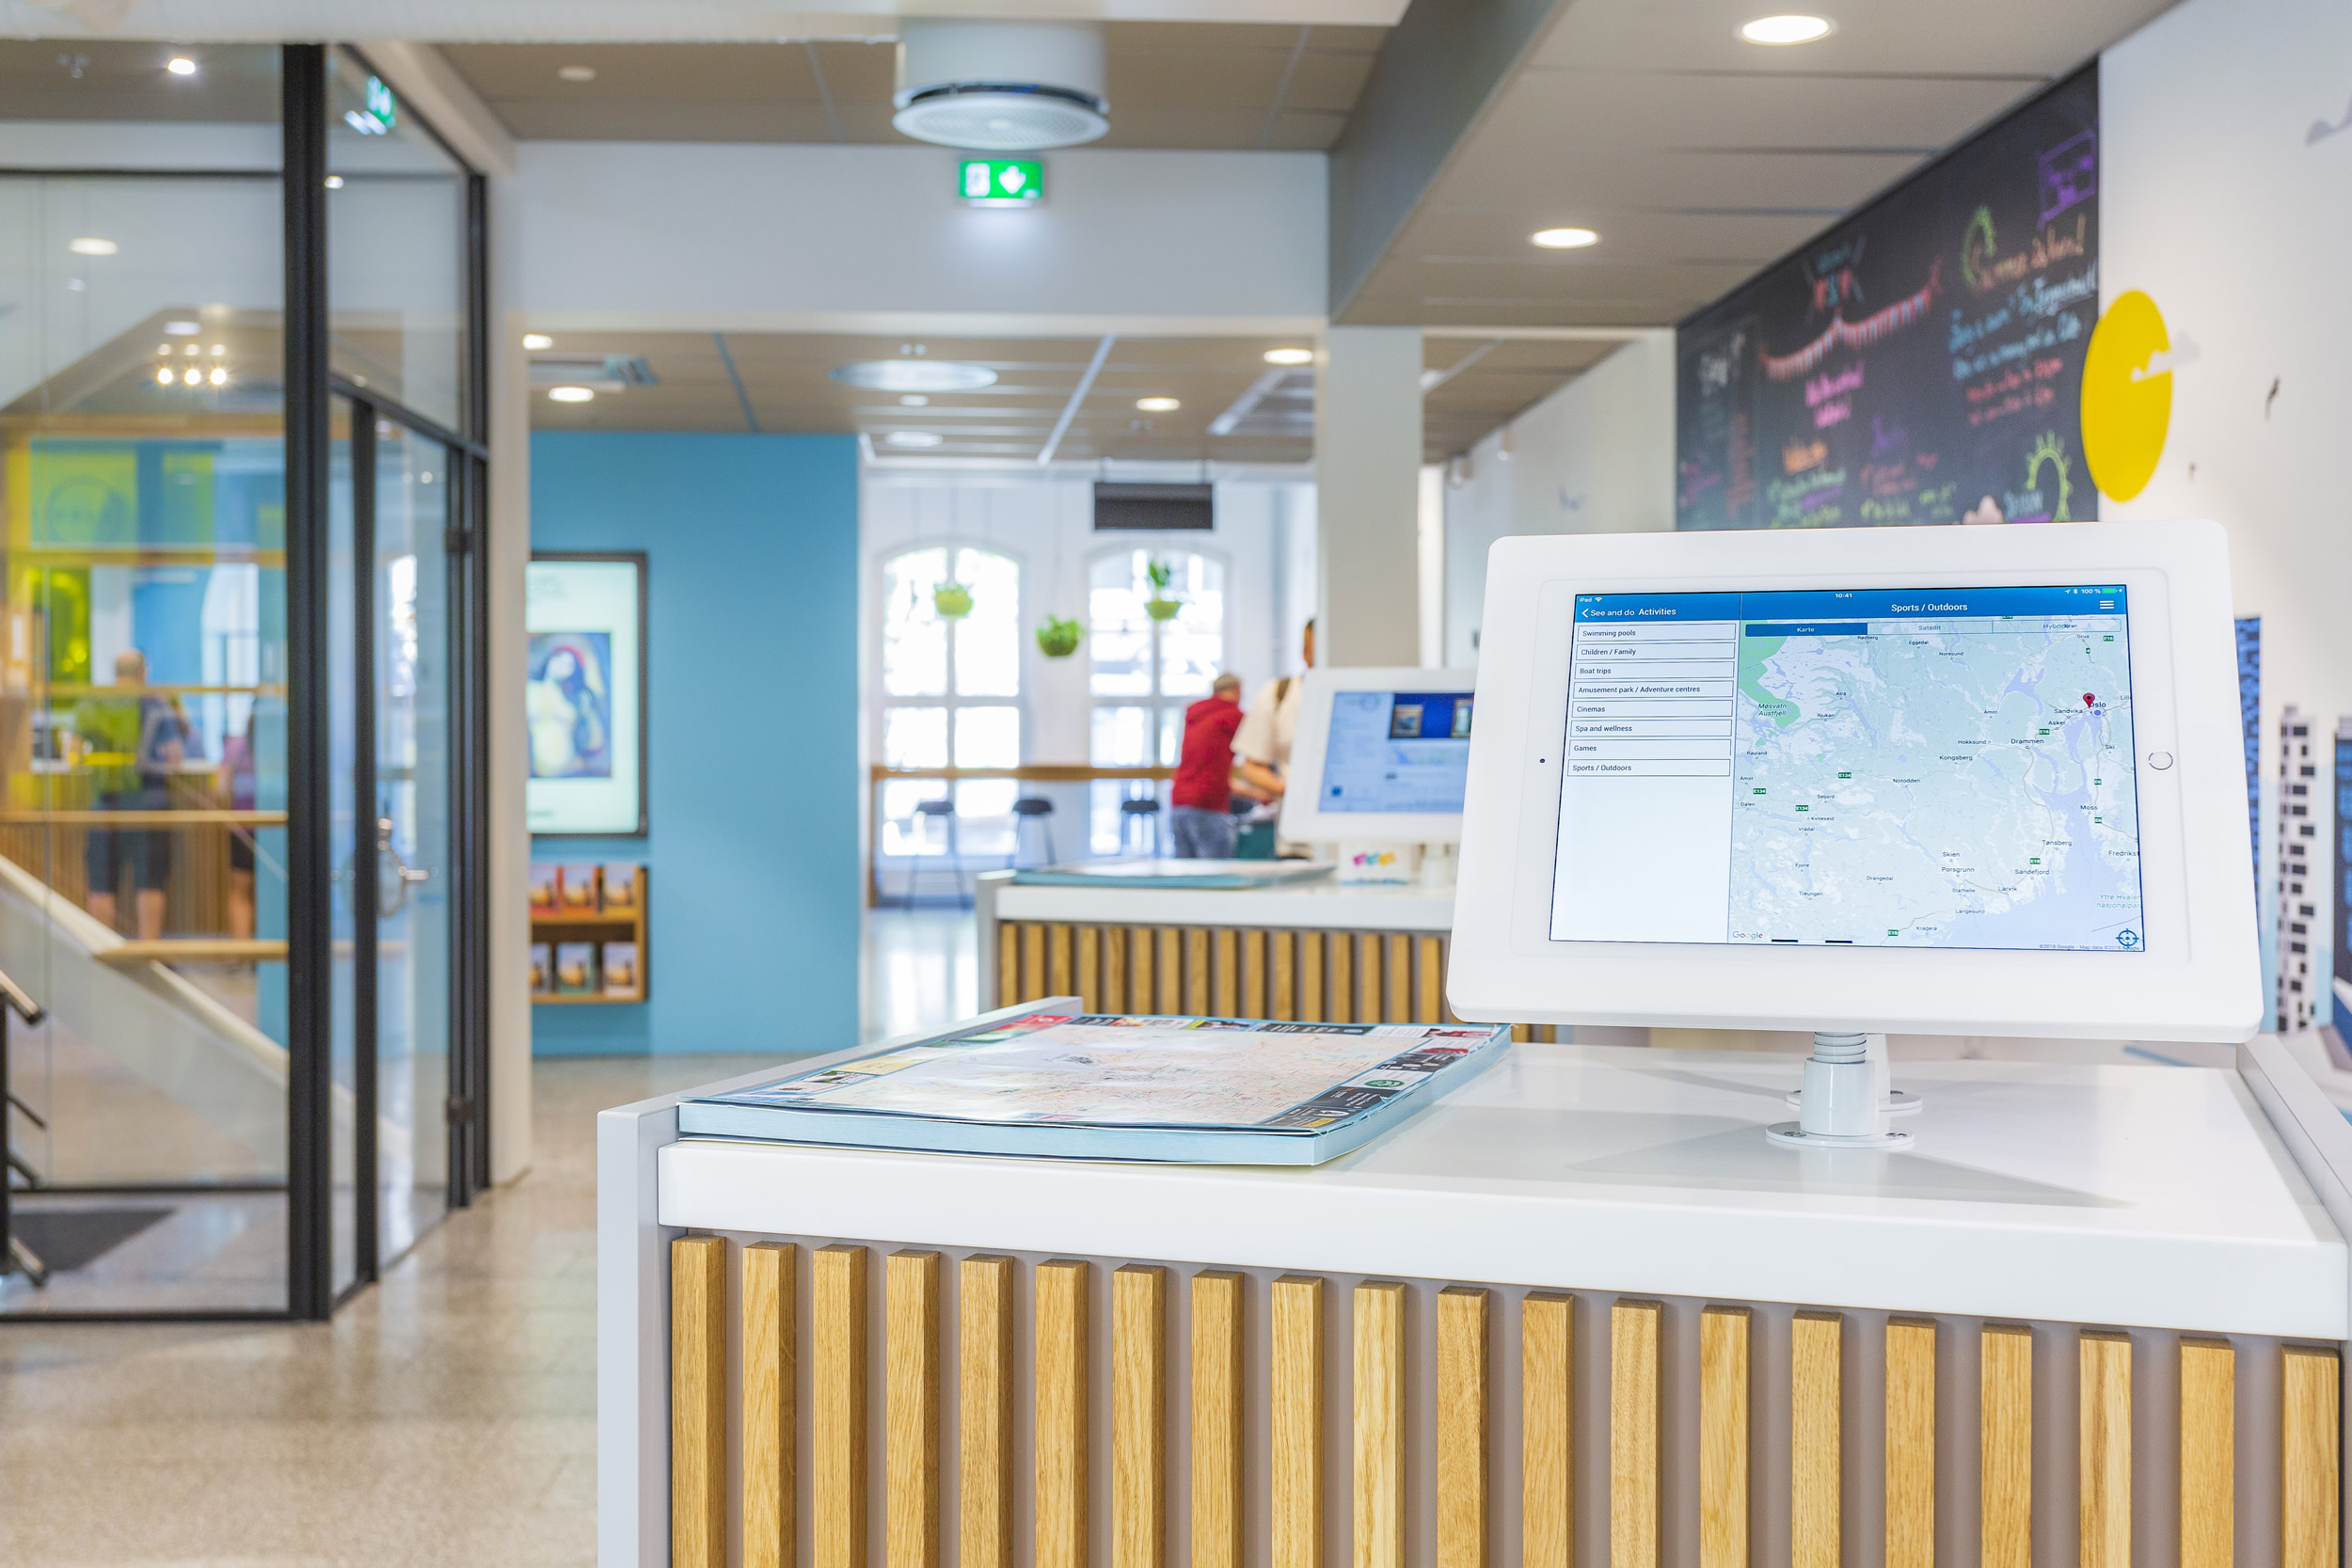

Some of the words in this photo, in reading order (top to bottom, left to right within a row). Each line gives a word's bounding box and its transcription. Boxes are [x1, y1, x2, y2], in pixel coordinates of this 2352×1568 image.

[1891, 604, 1919, 613] Sports
[1921, 603, 1926, 612] /
[1928, 603, 1968, 611] Outdoors
[1582, 629, 1616, 638] Swimming
[1732, 930, 1763, 941] Google
